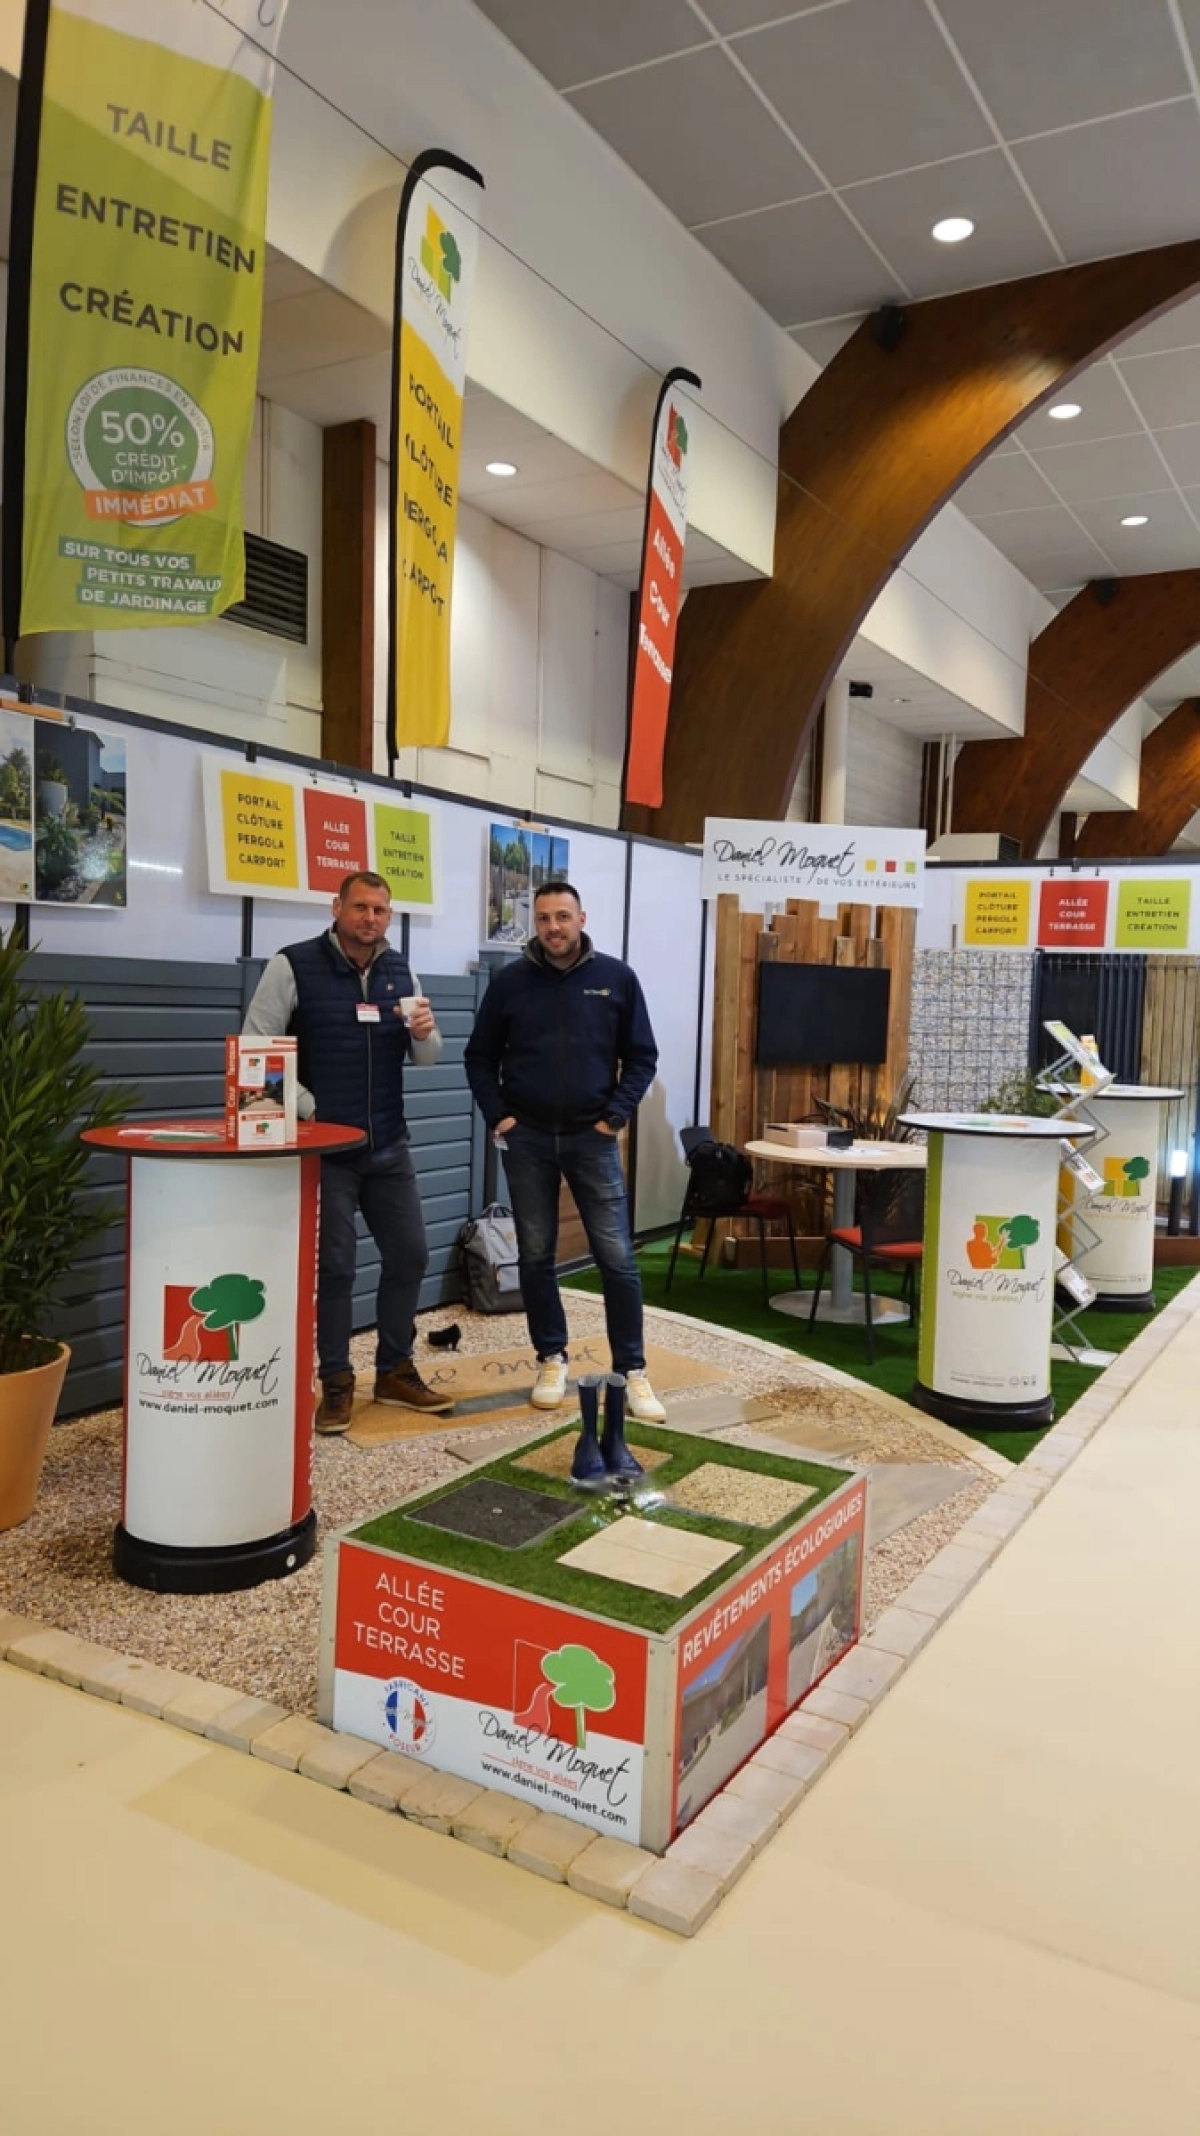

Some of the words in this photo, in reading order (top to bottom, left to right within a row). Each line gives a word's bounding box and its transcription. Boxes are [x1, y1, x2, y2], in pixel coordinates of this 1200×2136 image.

[106, 103, 233, 172] TAILLE
[56, 184, 256, 275] ENTRETIEN
[59, 282, 243, 356] CRÉATION
[108, 372, 172, 392] FINANCES
[101, 410, 185, 448] 50%
[115, 449, 178, 469] CRÉDIT
[95, 487, 207, 516] IMMÉDIAT
[64, 541, 100, 560] SUR
[106, 547, 150, 568] TOUS
[155, 554, 190, 571] VOS
[86, 566, 147, 587] PETITS
[81, 587, 105, 603] DE
[110, 591, 207, 614] JARDINAGE
[238, 792, 281, 811] PORTAIL
[236, 812, 284, 831] CLÔTURE
[323, 818, 350, 835] ALLÉE
[237, 833, 285, 850] PERGOLA
[325, 839, 350, 852] COUR
[390, 830, 416, 845] TAILLE
[239, 853, 286, 869] CARPORT
[316, 855, 360, 872] TERRASSE
[383, 847, 425, 863] ENTRETIEN
[713, 837, 777, 868] Daniel
[777, 841, 856, 885] Moquet
[385, 865, 424, 880] CRÉATION
[718, 874, 730, 882] LE
[734, 873, 802, 884] SPÉCIALISTE
[816, 877, 829, 886] DE
[835, 879, 853, 887] VOS
[857, 879, 917, 889] EXTÉRIEURS
[978, 891, 1017, 899] PORTAIL
[1058, 896, 1089, 907] ALLÉE
[1137, 897, 1171, 905] TAILLE
[977, 901, 1019, 911] CLÔTURE
[1059, 910, 1086, 918] COUR
[1126, 910, 1180, 918] ENTRETIEN
[976, 915, 1018, 923] PERGOLA
[1049, 923, 1096, 931] TERRASSE
[1127, 921, 1178, 931] CRÉATION
[976, 927, 1018, 935] CARPORT
[947, 1268, 994, 1291] Daniel
[137, 1352, 191, 1383] Daniel
[193, 1346, 281, 1401] Moquet
[138, 1398, 279, 1416] www.daniel-moquet.com
[683, 1560, 783, 1668] REVÊTEMENTS
[784, 1492, 863, 1577] ÉCOLOGIQUES
[375, 1571, 446, 1612] ALLÉE
[378, 1601, 441, 1641] COUR
[353, 1621, 466, 1680] TERRASSE
[478, 1710, 544, 1754] Daniel
[543, 1734, 631, 1807] Moquet
[481, 1760, 628, 1826] www.daniel-moquet.com
